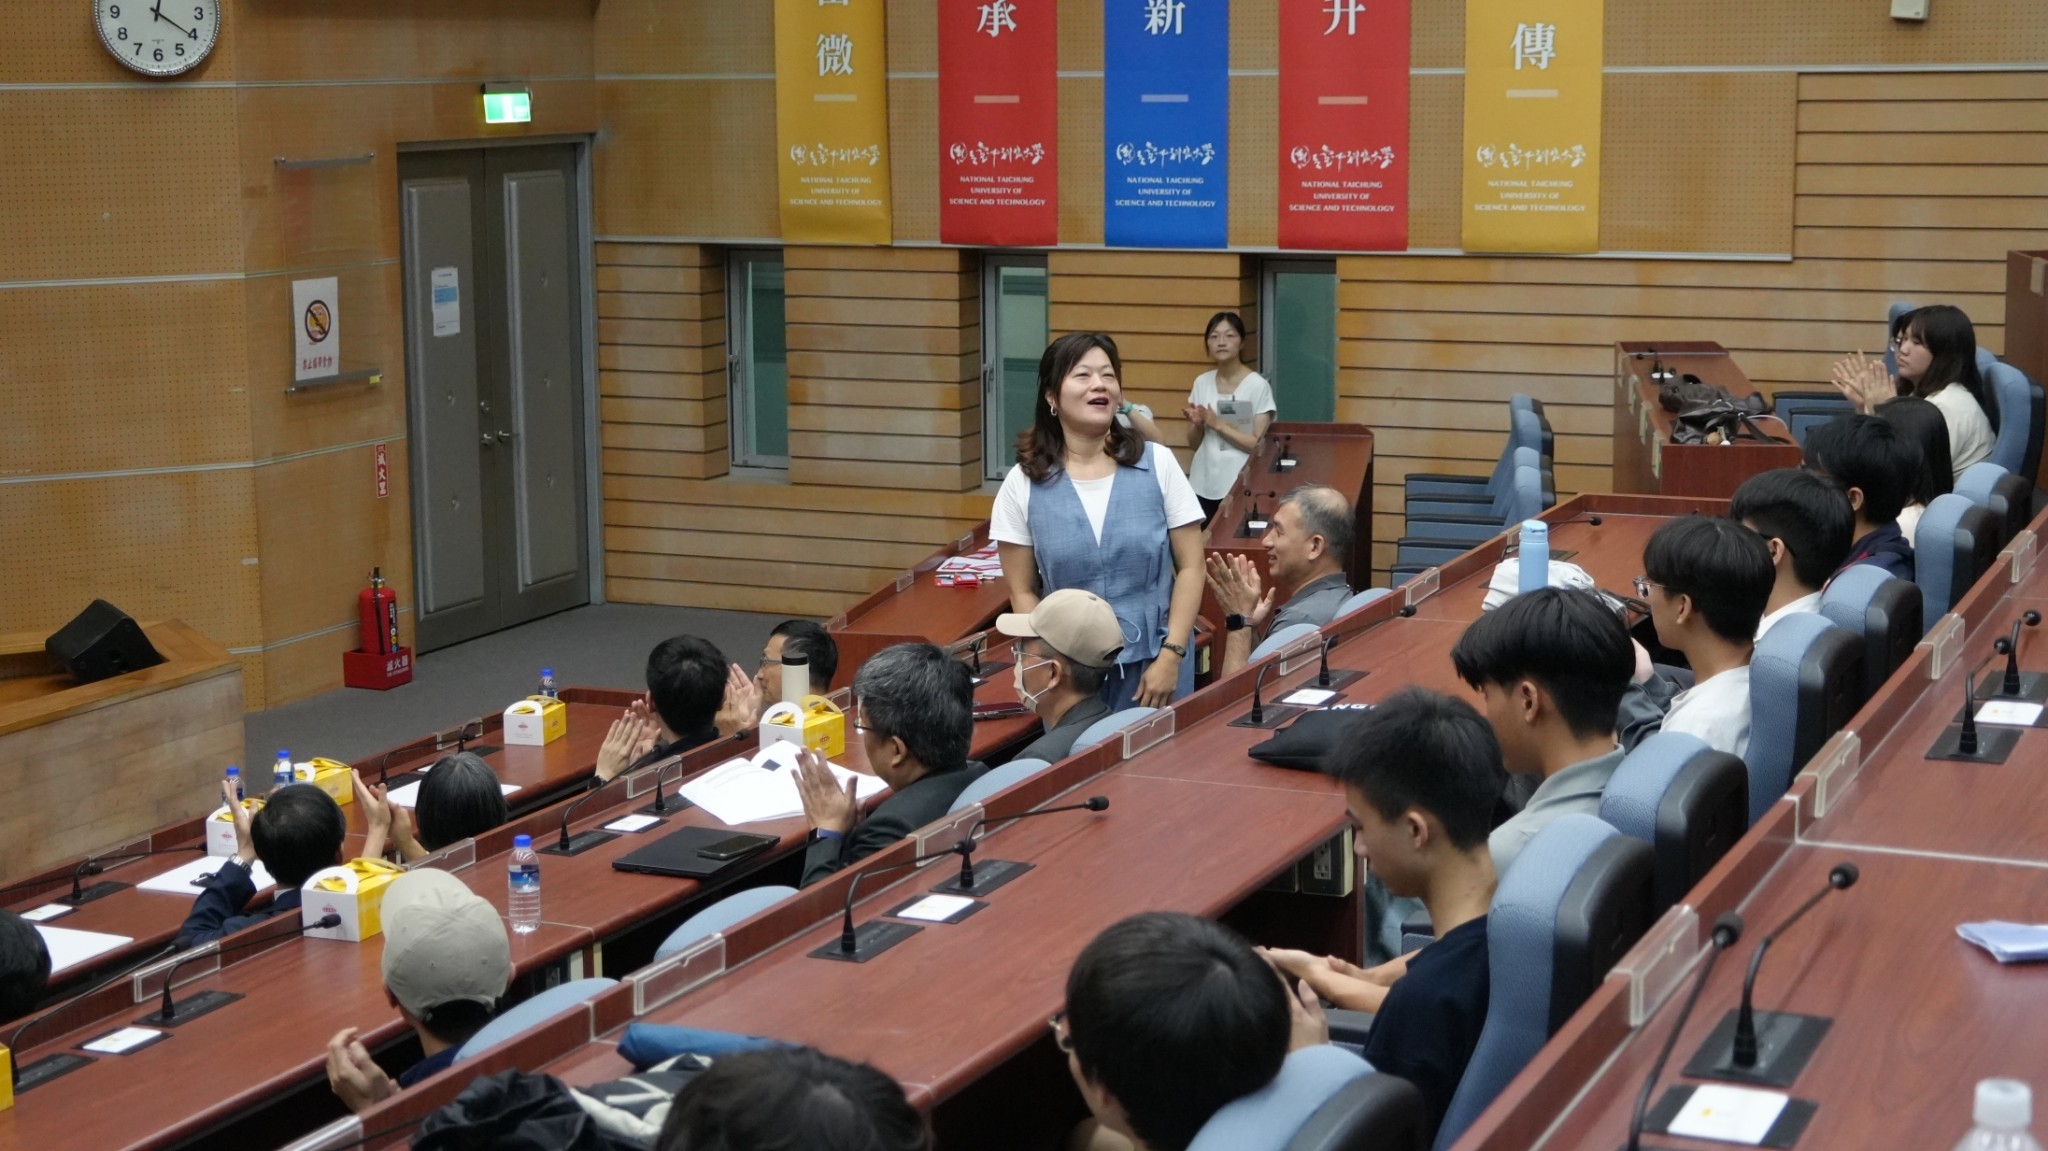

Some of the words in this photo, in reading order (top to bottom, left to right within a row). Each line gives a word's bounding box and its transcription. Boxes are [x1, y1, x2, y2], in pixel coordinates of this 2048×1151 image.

[110, 5, 120, 19] 9
[194, 7, 204, 20] 3
[977, 0, 1017, 37] 承
[1144, 0, 1186, 35] 新
[117, 27, 128, 40] 8
[188, 28, 198, 40] 4
[133, 43, 143, 55] 7
[175, 44, 185, 56] 5
[1510, 23, 1556, 70] 傳
[153, 49, 164, 61] 6
[996, 198, 1046, 206] TECHNOLOGY
